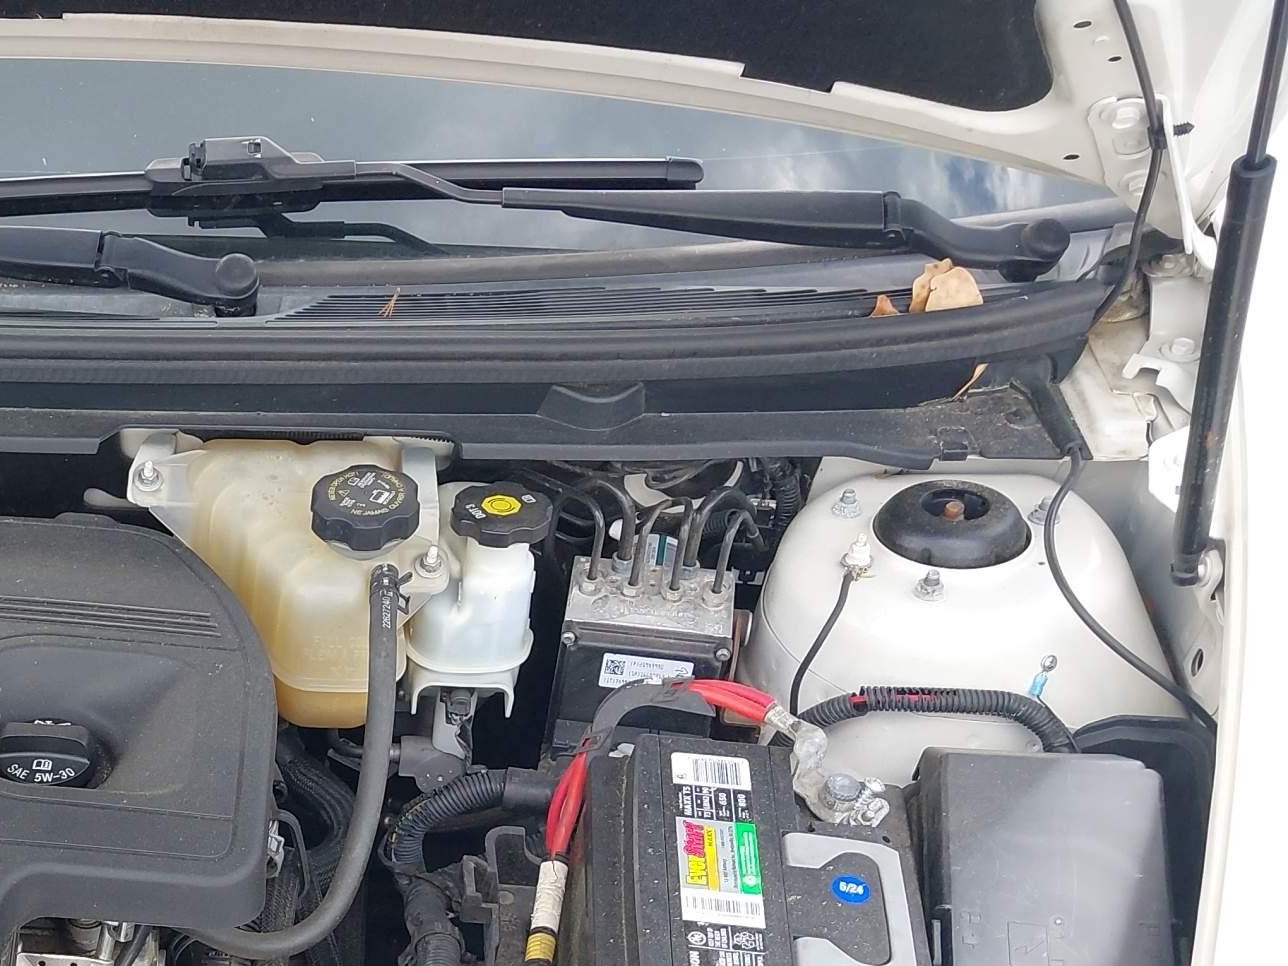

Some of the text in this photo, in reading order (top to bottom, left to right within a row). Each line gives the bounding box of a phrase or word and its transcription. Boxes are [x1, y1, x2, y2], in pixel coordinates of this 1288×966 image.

[468, 507, 487, 519] DOT
[7, 763, 76, 783] SAE 5W-30
[718, 792, 728, 806] 650
